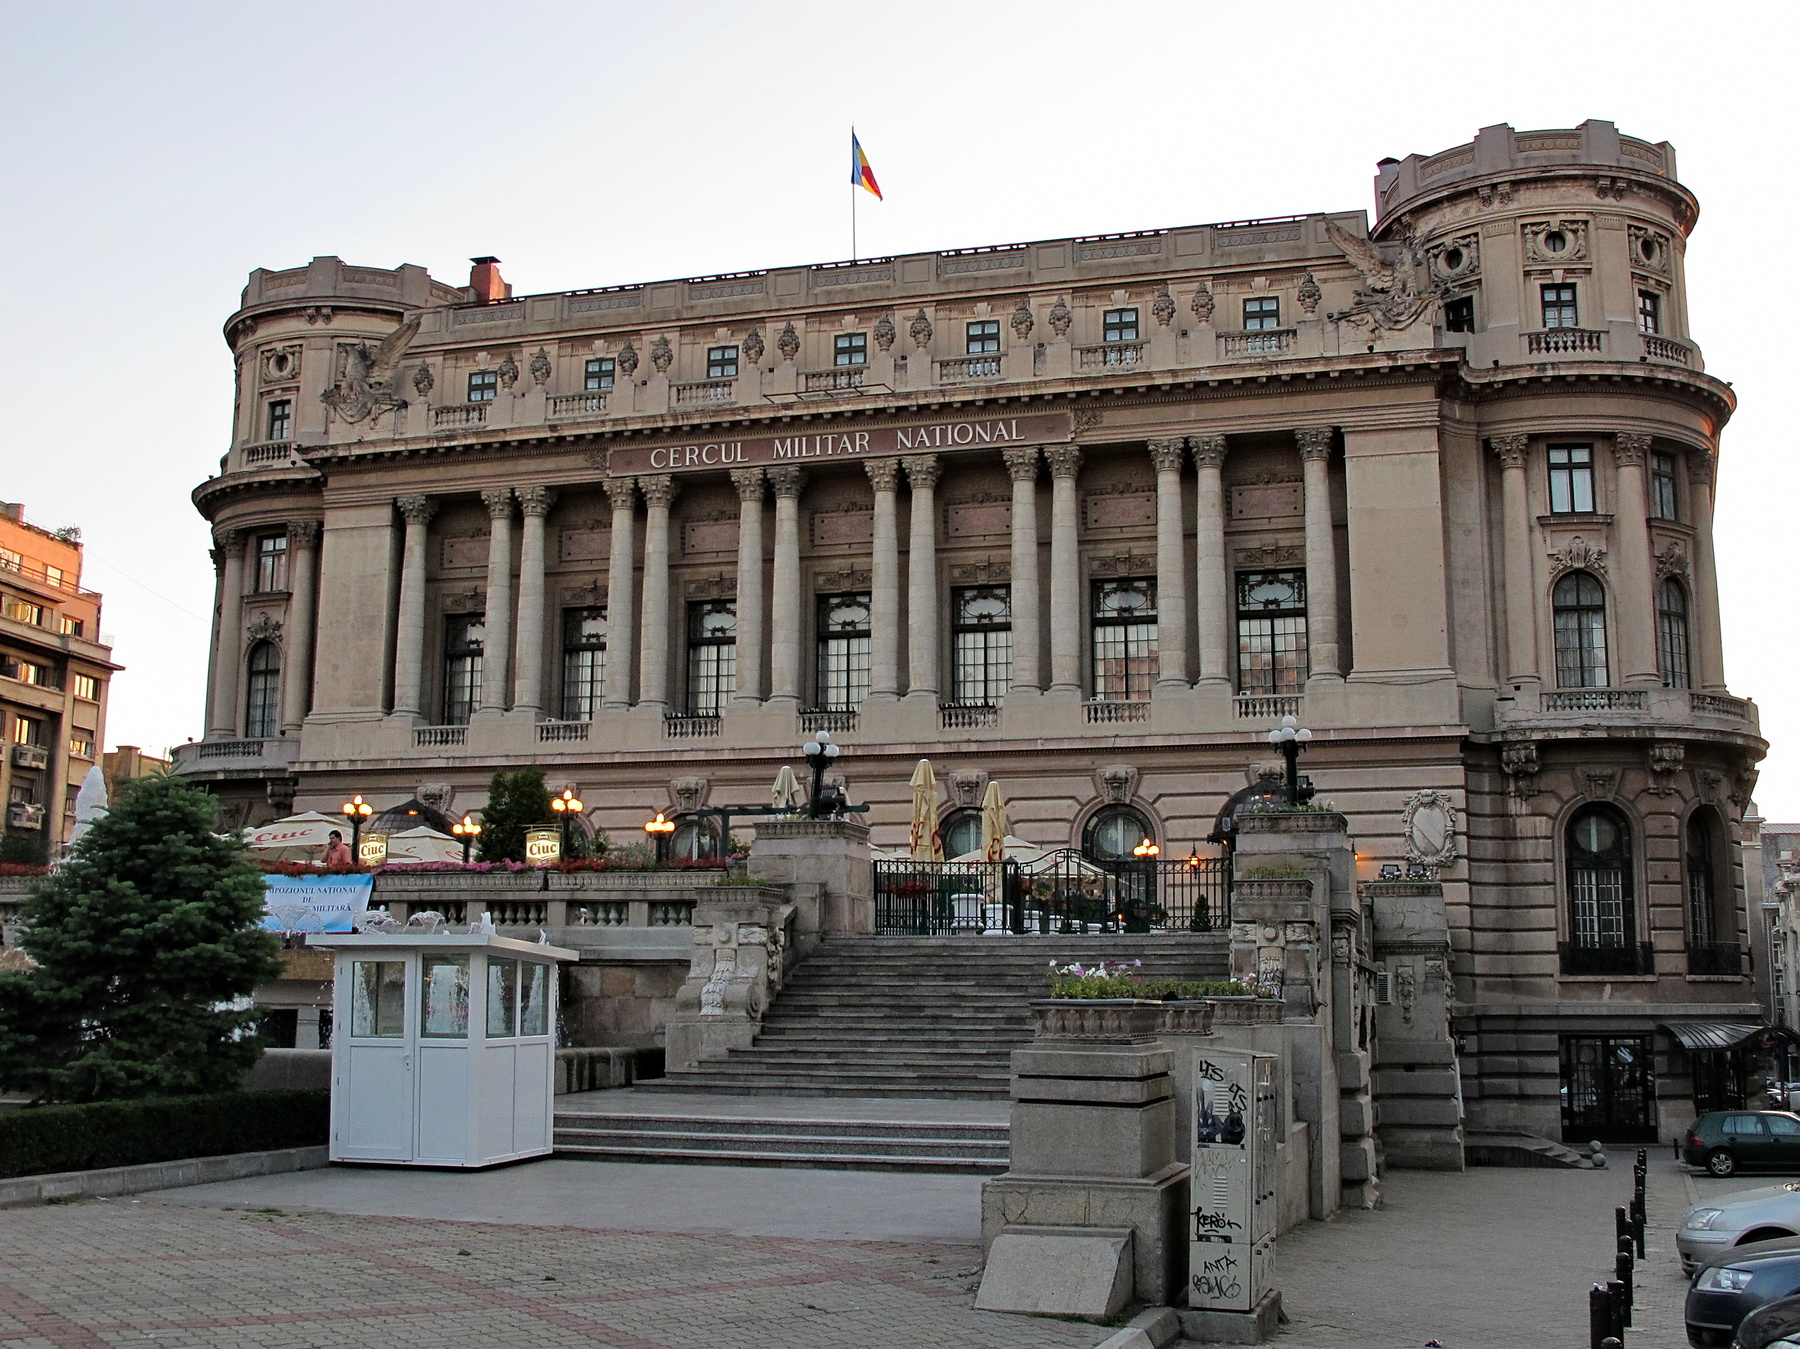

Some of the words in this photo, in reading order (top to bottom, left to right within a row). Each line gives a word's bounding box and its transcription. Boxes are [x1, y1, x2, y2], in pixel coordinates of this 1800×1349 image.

[650, 442, 749, 469] CERCUL
[773, 432, 870, 460] MILITAR
[897, 420, 1025, 450] NATIONAL
[255, 828, 313, 842] Ciuc
[361, 844, 384, 857] Ciuc
[529, 843, 557, 856] Ciuc
[302, 896, 314, 904] DE
